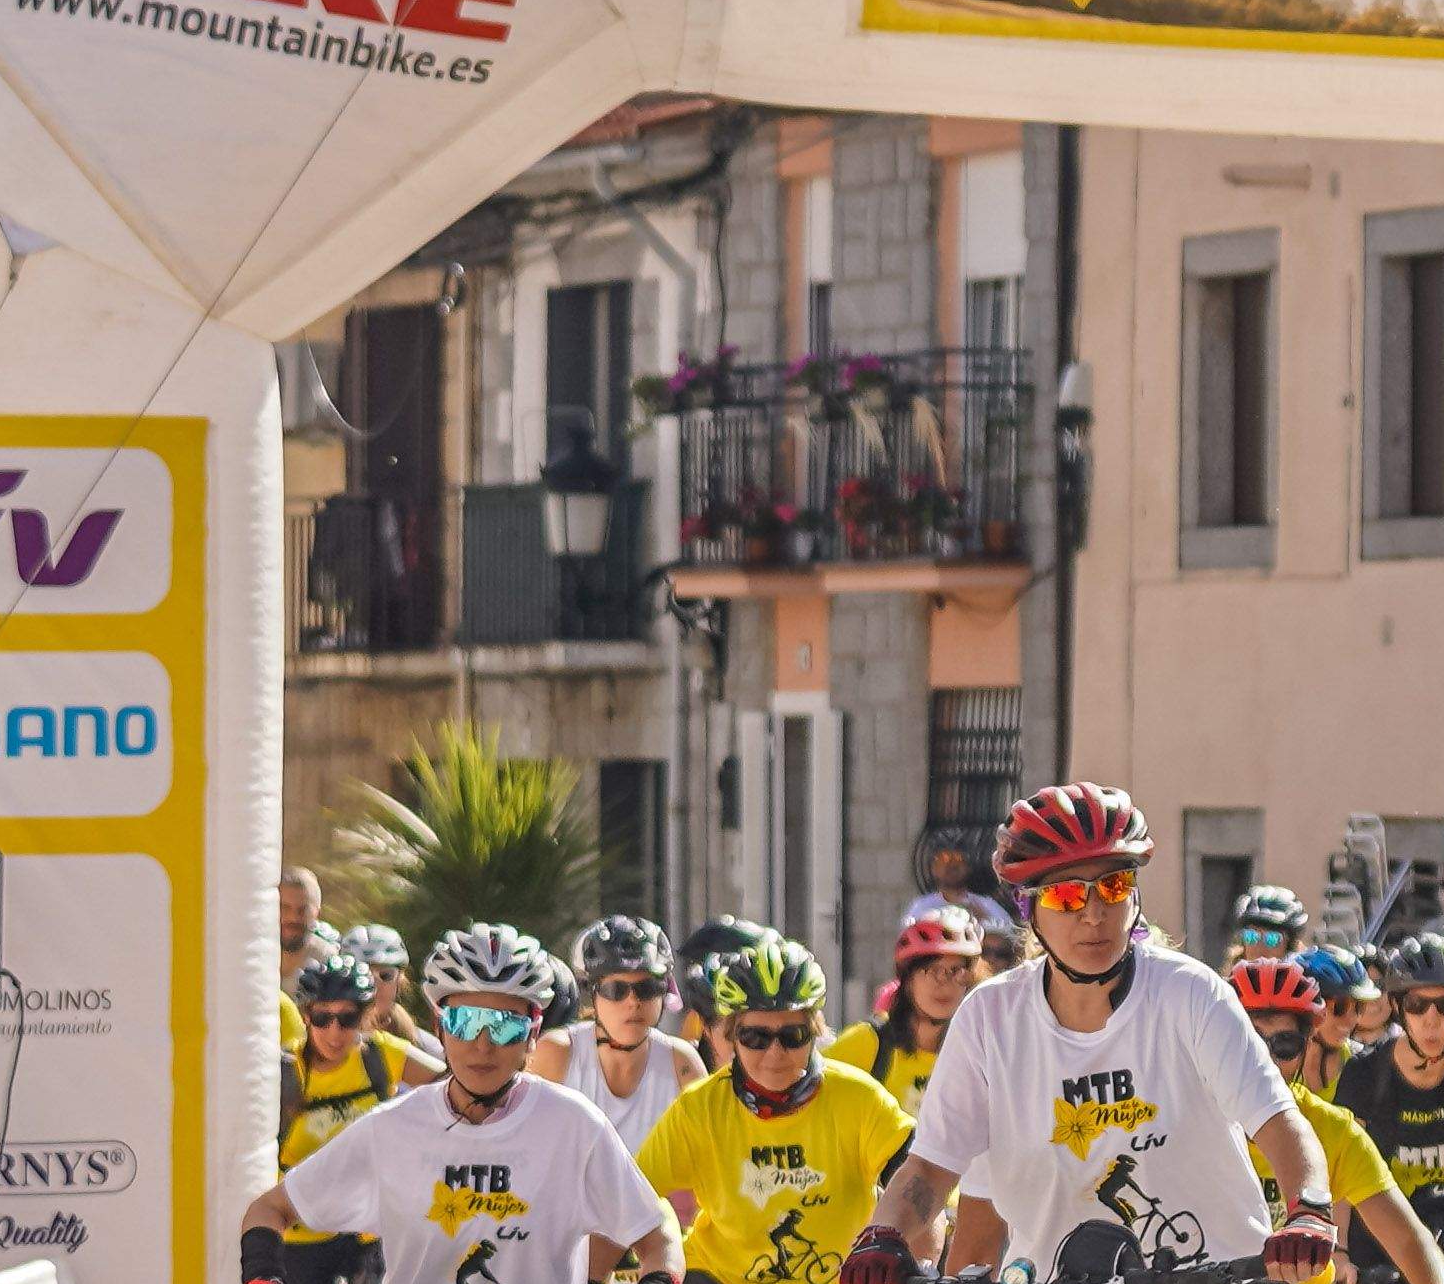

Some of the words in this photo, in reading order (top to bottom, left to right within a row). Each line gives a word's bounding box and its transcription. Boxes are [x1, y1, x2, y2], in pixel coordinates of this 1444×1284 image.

[2, 988, 112, 1012] MOLINOS
[1063, 1069, 1136, 1107] MTB
[1089, 1106, 1156, 1130] Mujer
[1131, 1134, 1168, 1152] Liv
[751, 1145, 805, 1169] MTB
[445, 1164, 511, 1193] MTB
